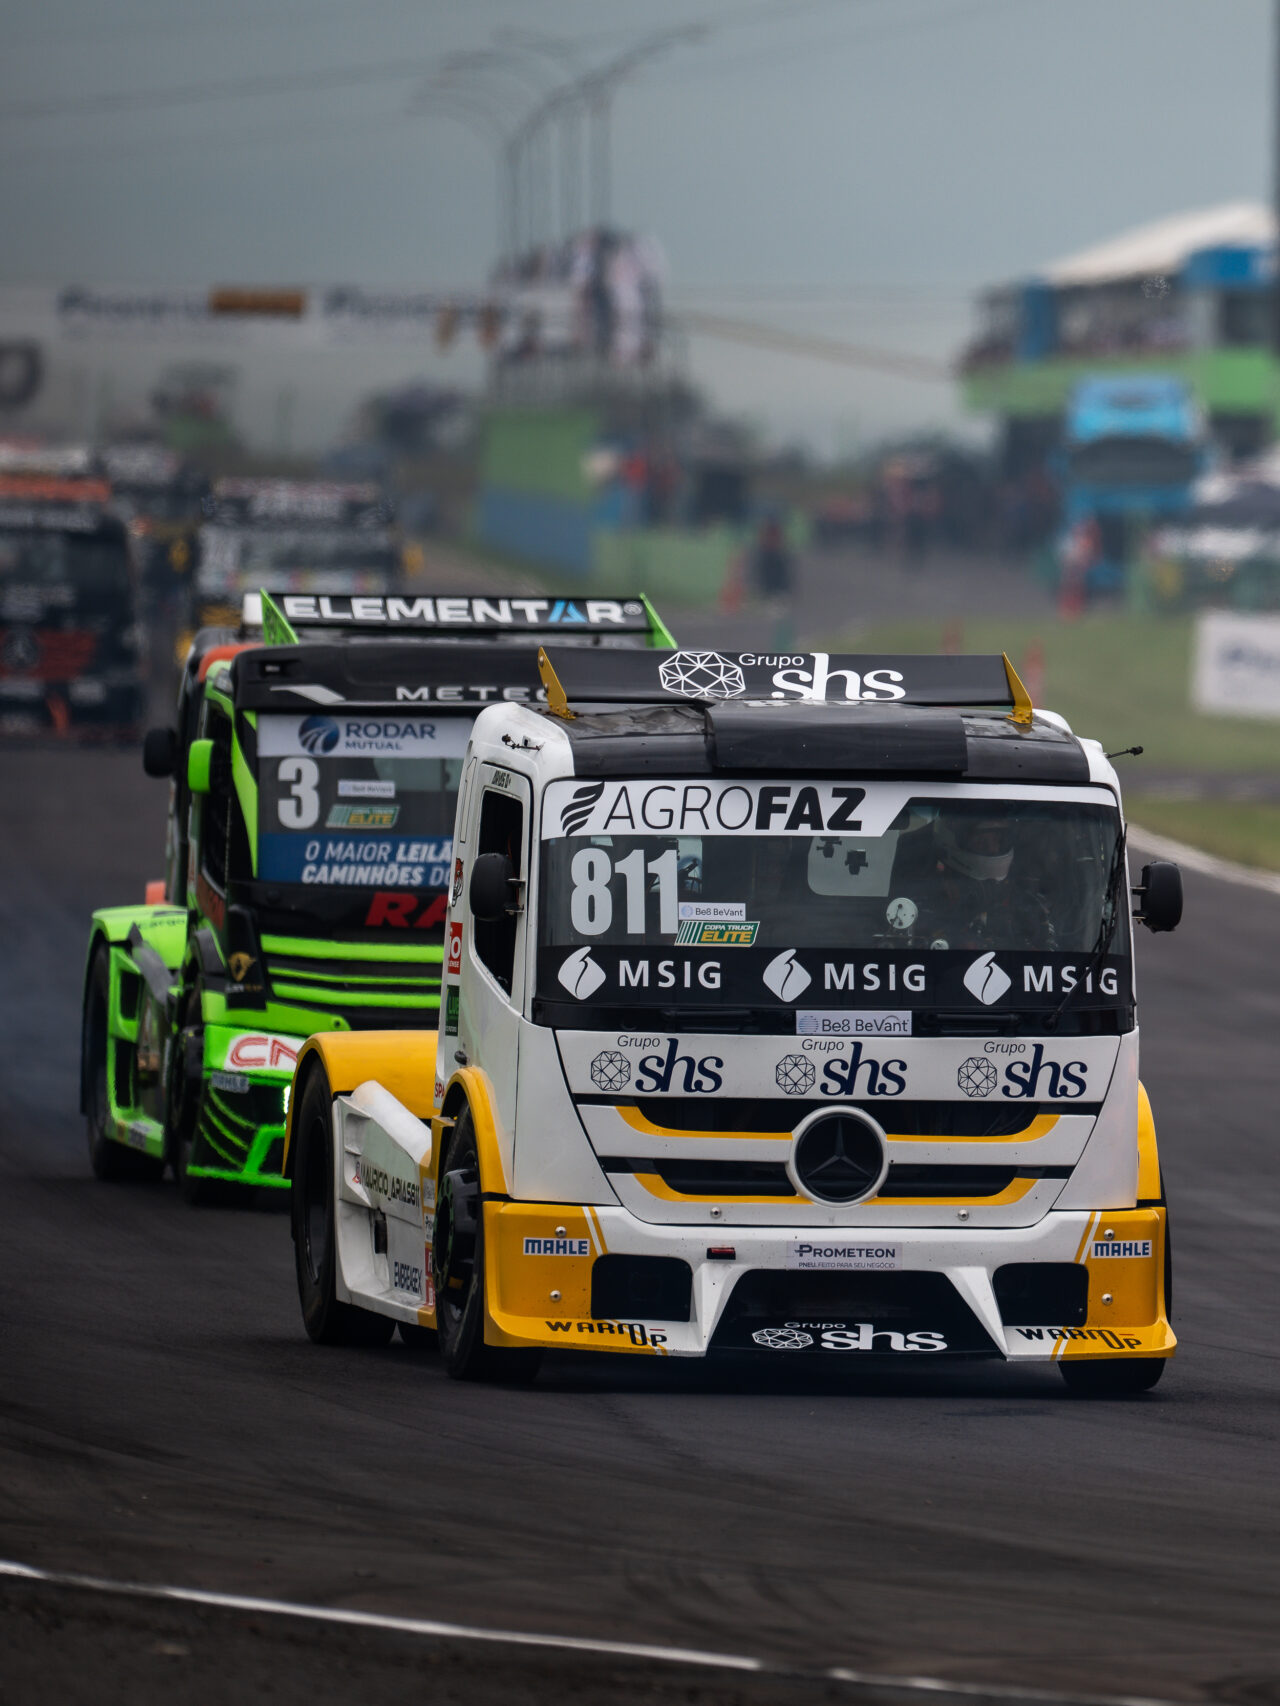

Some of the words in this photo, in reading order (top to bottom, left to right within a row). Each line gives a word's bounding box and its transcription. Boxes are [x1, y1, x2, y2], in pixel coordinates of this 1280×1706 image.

[738, 654, 805, 669] Grupo
[771, 652, 906, 700] shs
[345, 723, 436, 739] RODAR
[345, 740, 403, 751] MUTUAL
[277, 757, 320, 830] 3
[602, 785, 867, 831] AGROFAZ
[350, 814, 393, 825] ELITE
[305, 841, 320, 861] O
[325, 841, 391, 861] MAIOR
[302, 863, 424, 886] CAMINHÕES
[570, 848, 679, 936] 811
[695, 907, 712, 917] Be8
[713, 907, 744, 918] BeVant
[701, 931, 752, 943] ELITE
[618, 960, 722, 989] MSIG
[824, 963, 926, 991] MSIG
[1023, 965, 1119, 995] MSIG
[821, 1019, 852, 1032] Be8
[855, 1018, 909, 1033] BeVant
[617, 1035, 660, 1049] Grupo
[801, 1039, 844, 1053] Grupo
[983, 1041, 1026, 1055] Grupo
[635, 1038, 724, 1093] shs
[819, 1041, 908, 1096] shs
[1001, 1043, 1088, 1098] shs
[524, 1238, 589, 1254] MAHLE
[794, 1244, 896, 1258] PROMETEON
[1094, 1241, 1150, 1257] MAHLE
[784, 1321, 846, 1330] Grupo
[820, 1323, 948, 1351] shs
